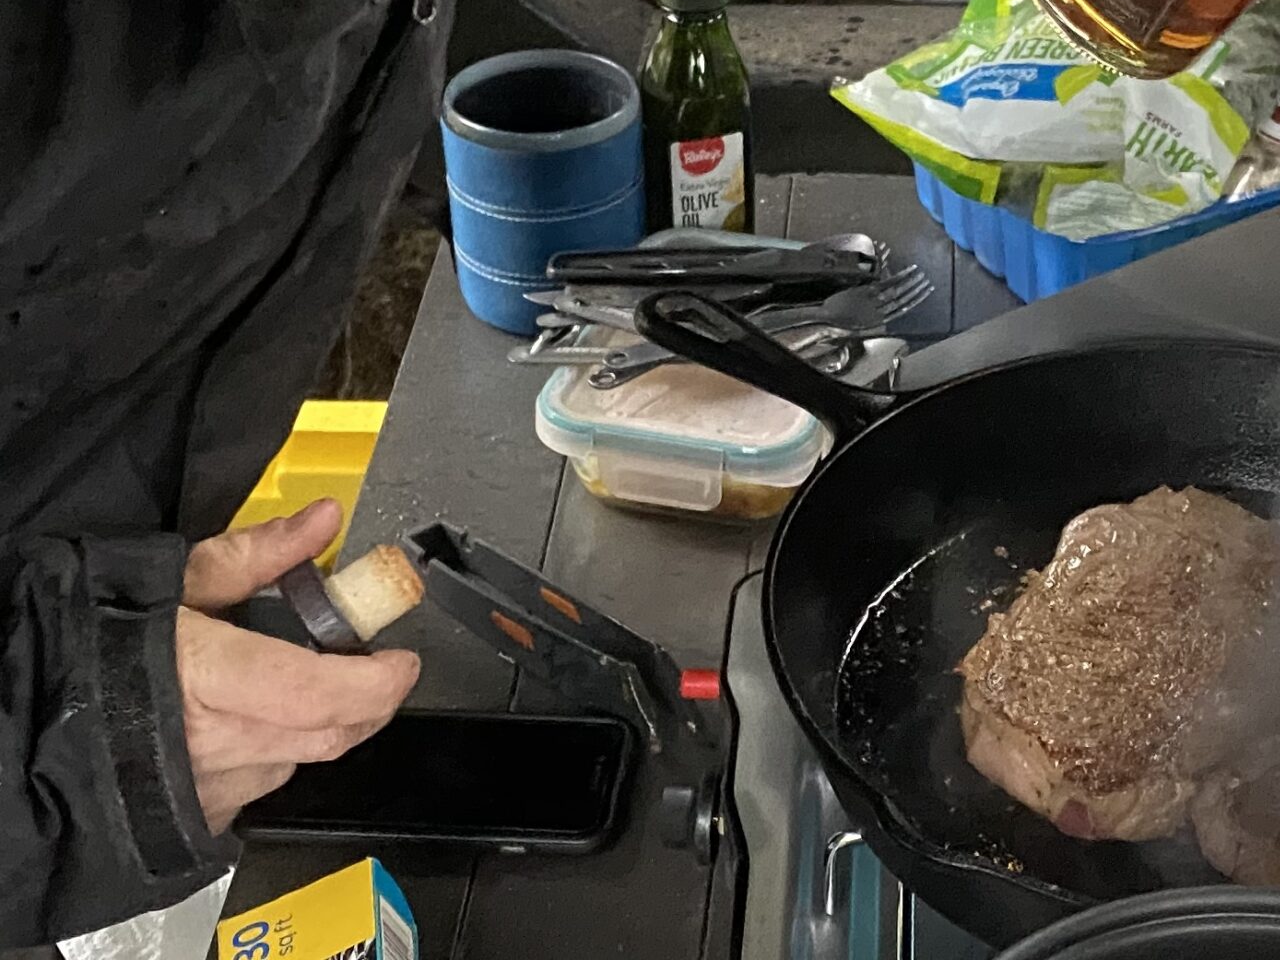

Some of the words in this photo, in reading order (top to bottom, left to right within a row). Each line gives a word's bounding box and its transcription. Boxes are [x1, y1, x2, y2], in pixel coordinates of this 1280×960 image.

[1145, 111, 1182, 139] FARMS
[681, 192, 719, 212] OLIVE
[682, 212, 704, 229] OIL
[232, 921, 270, 960] 30
